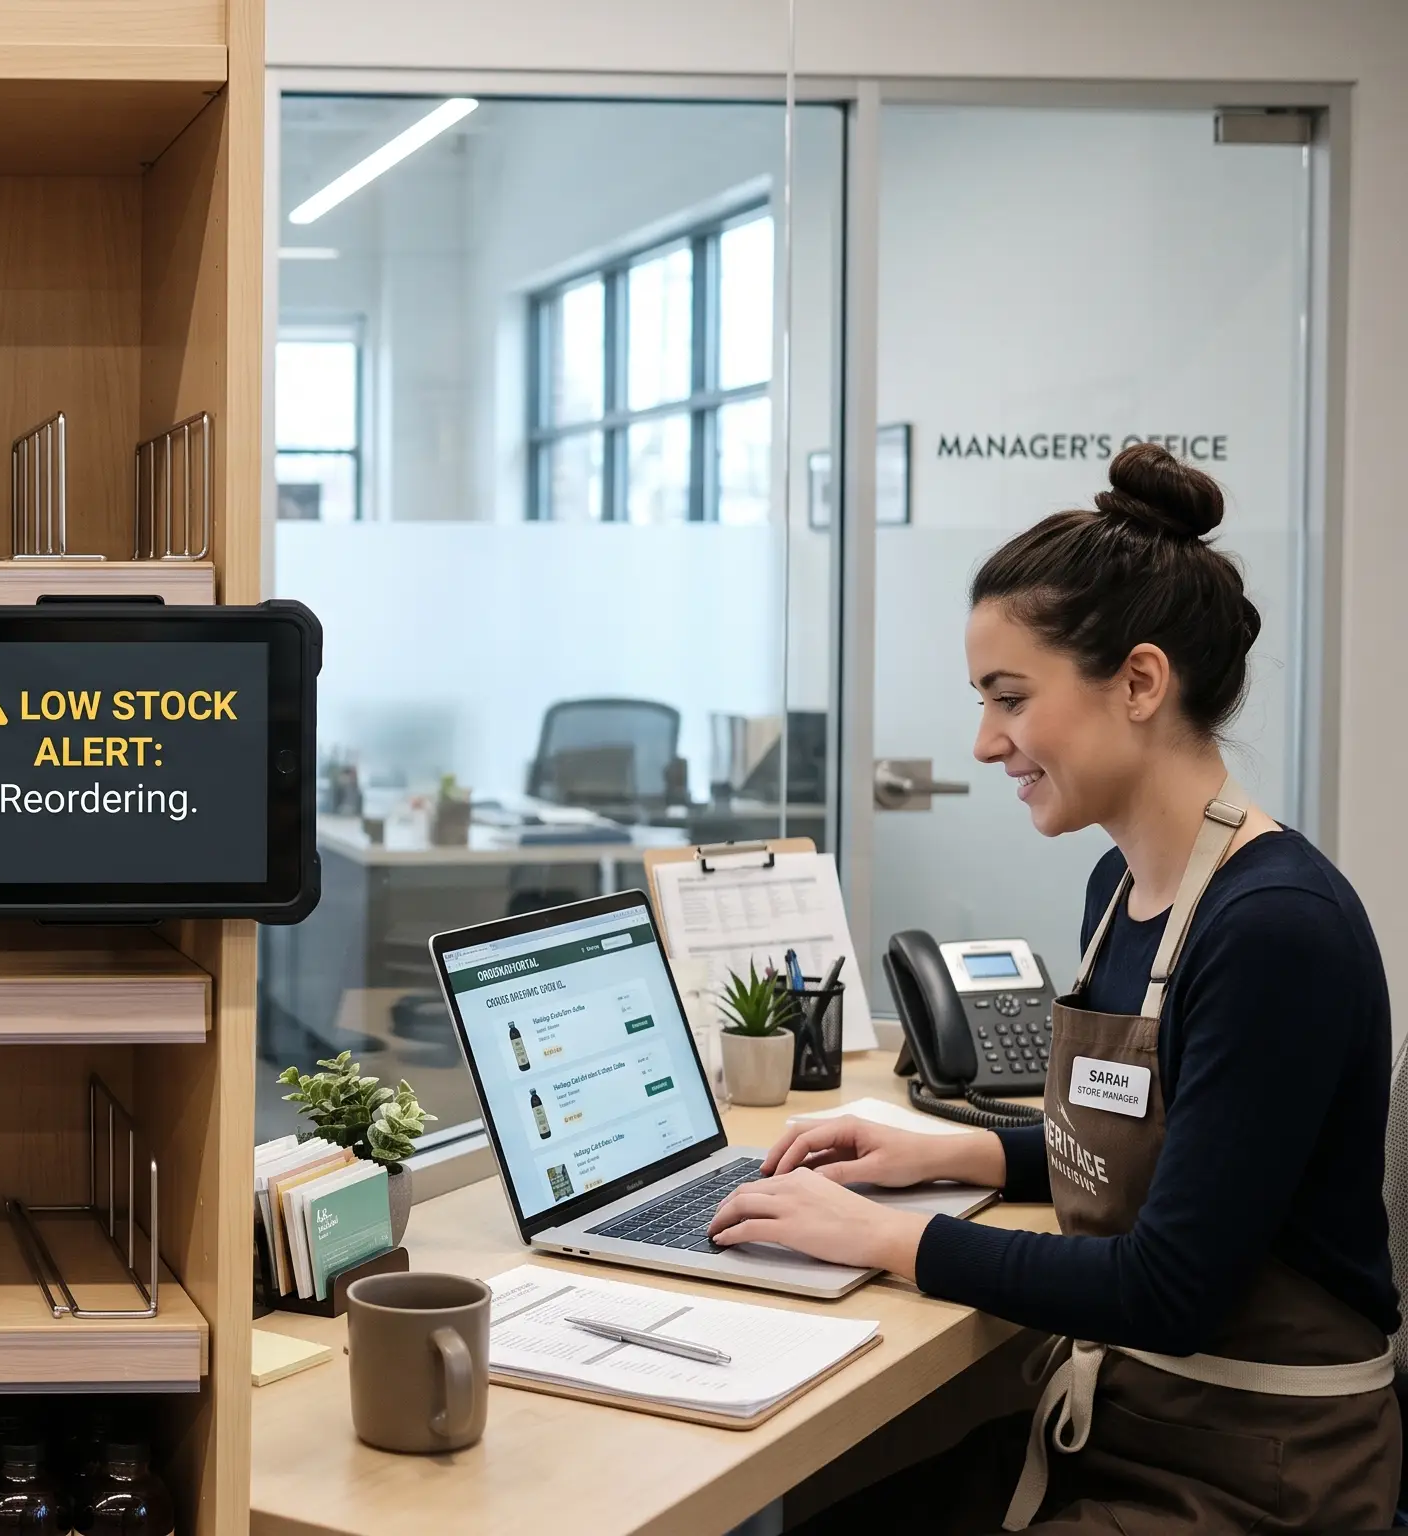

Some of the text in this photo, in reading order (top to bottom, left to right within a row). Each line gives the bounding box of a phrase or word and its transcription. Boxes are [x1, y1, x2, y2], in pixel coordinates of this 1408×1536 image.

[937, 433, 1112, 459] MANAGER'S
[21, 691, 238, 720] LOW STOCK
[33, 737, 163, 767] ALERT:
[0, 782, 198, 821] Reordering.
[1089, 1070, 1129, 1088] SARAH
[1077, 1086, 1139, 1104] STORE MANAGER
